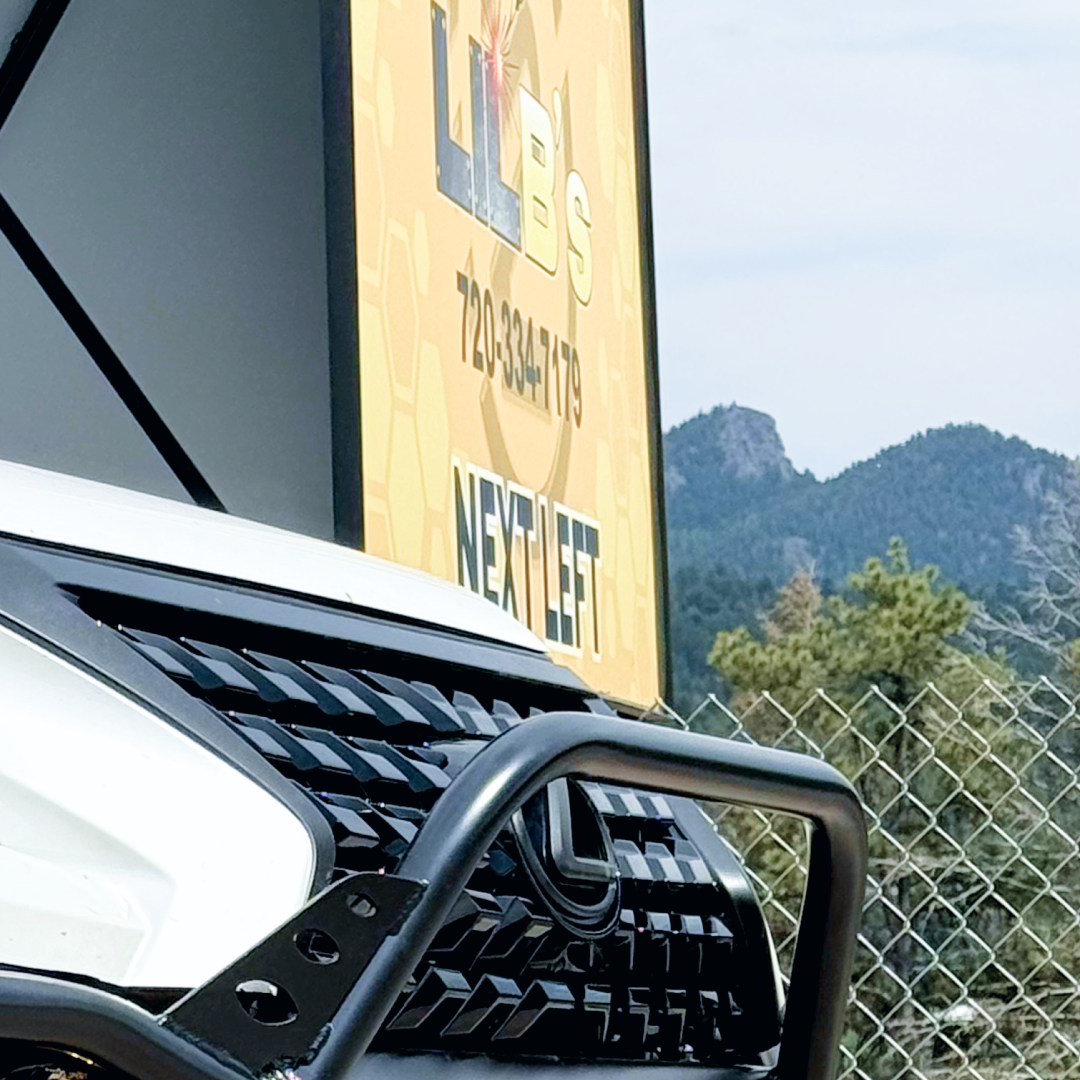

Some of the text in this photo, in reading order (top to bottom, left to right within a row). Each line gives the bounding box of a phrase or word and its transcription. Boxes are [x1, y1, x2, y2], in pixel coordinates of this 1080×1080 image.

[456, 270, 582, 429] 720-334-7179
[453, 462, 602, 658] NEXT LEFT
